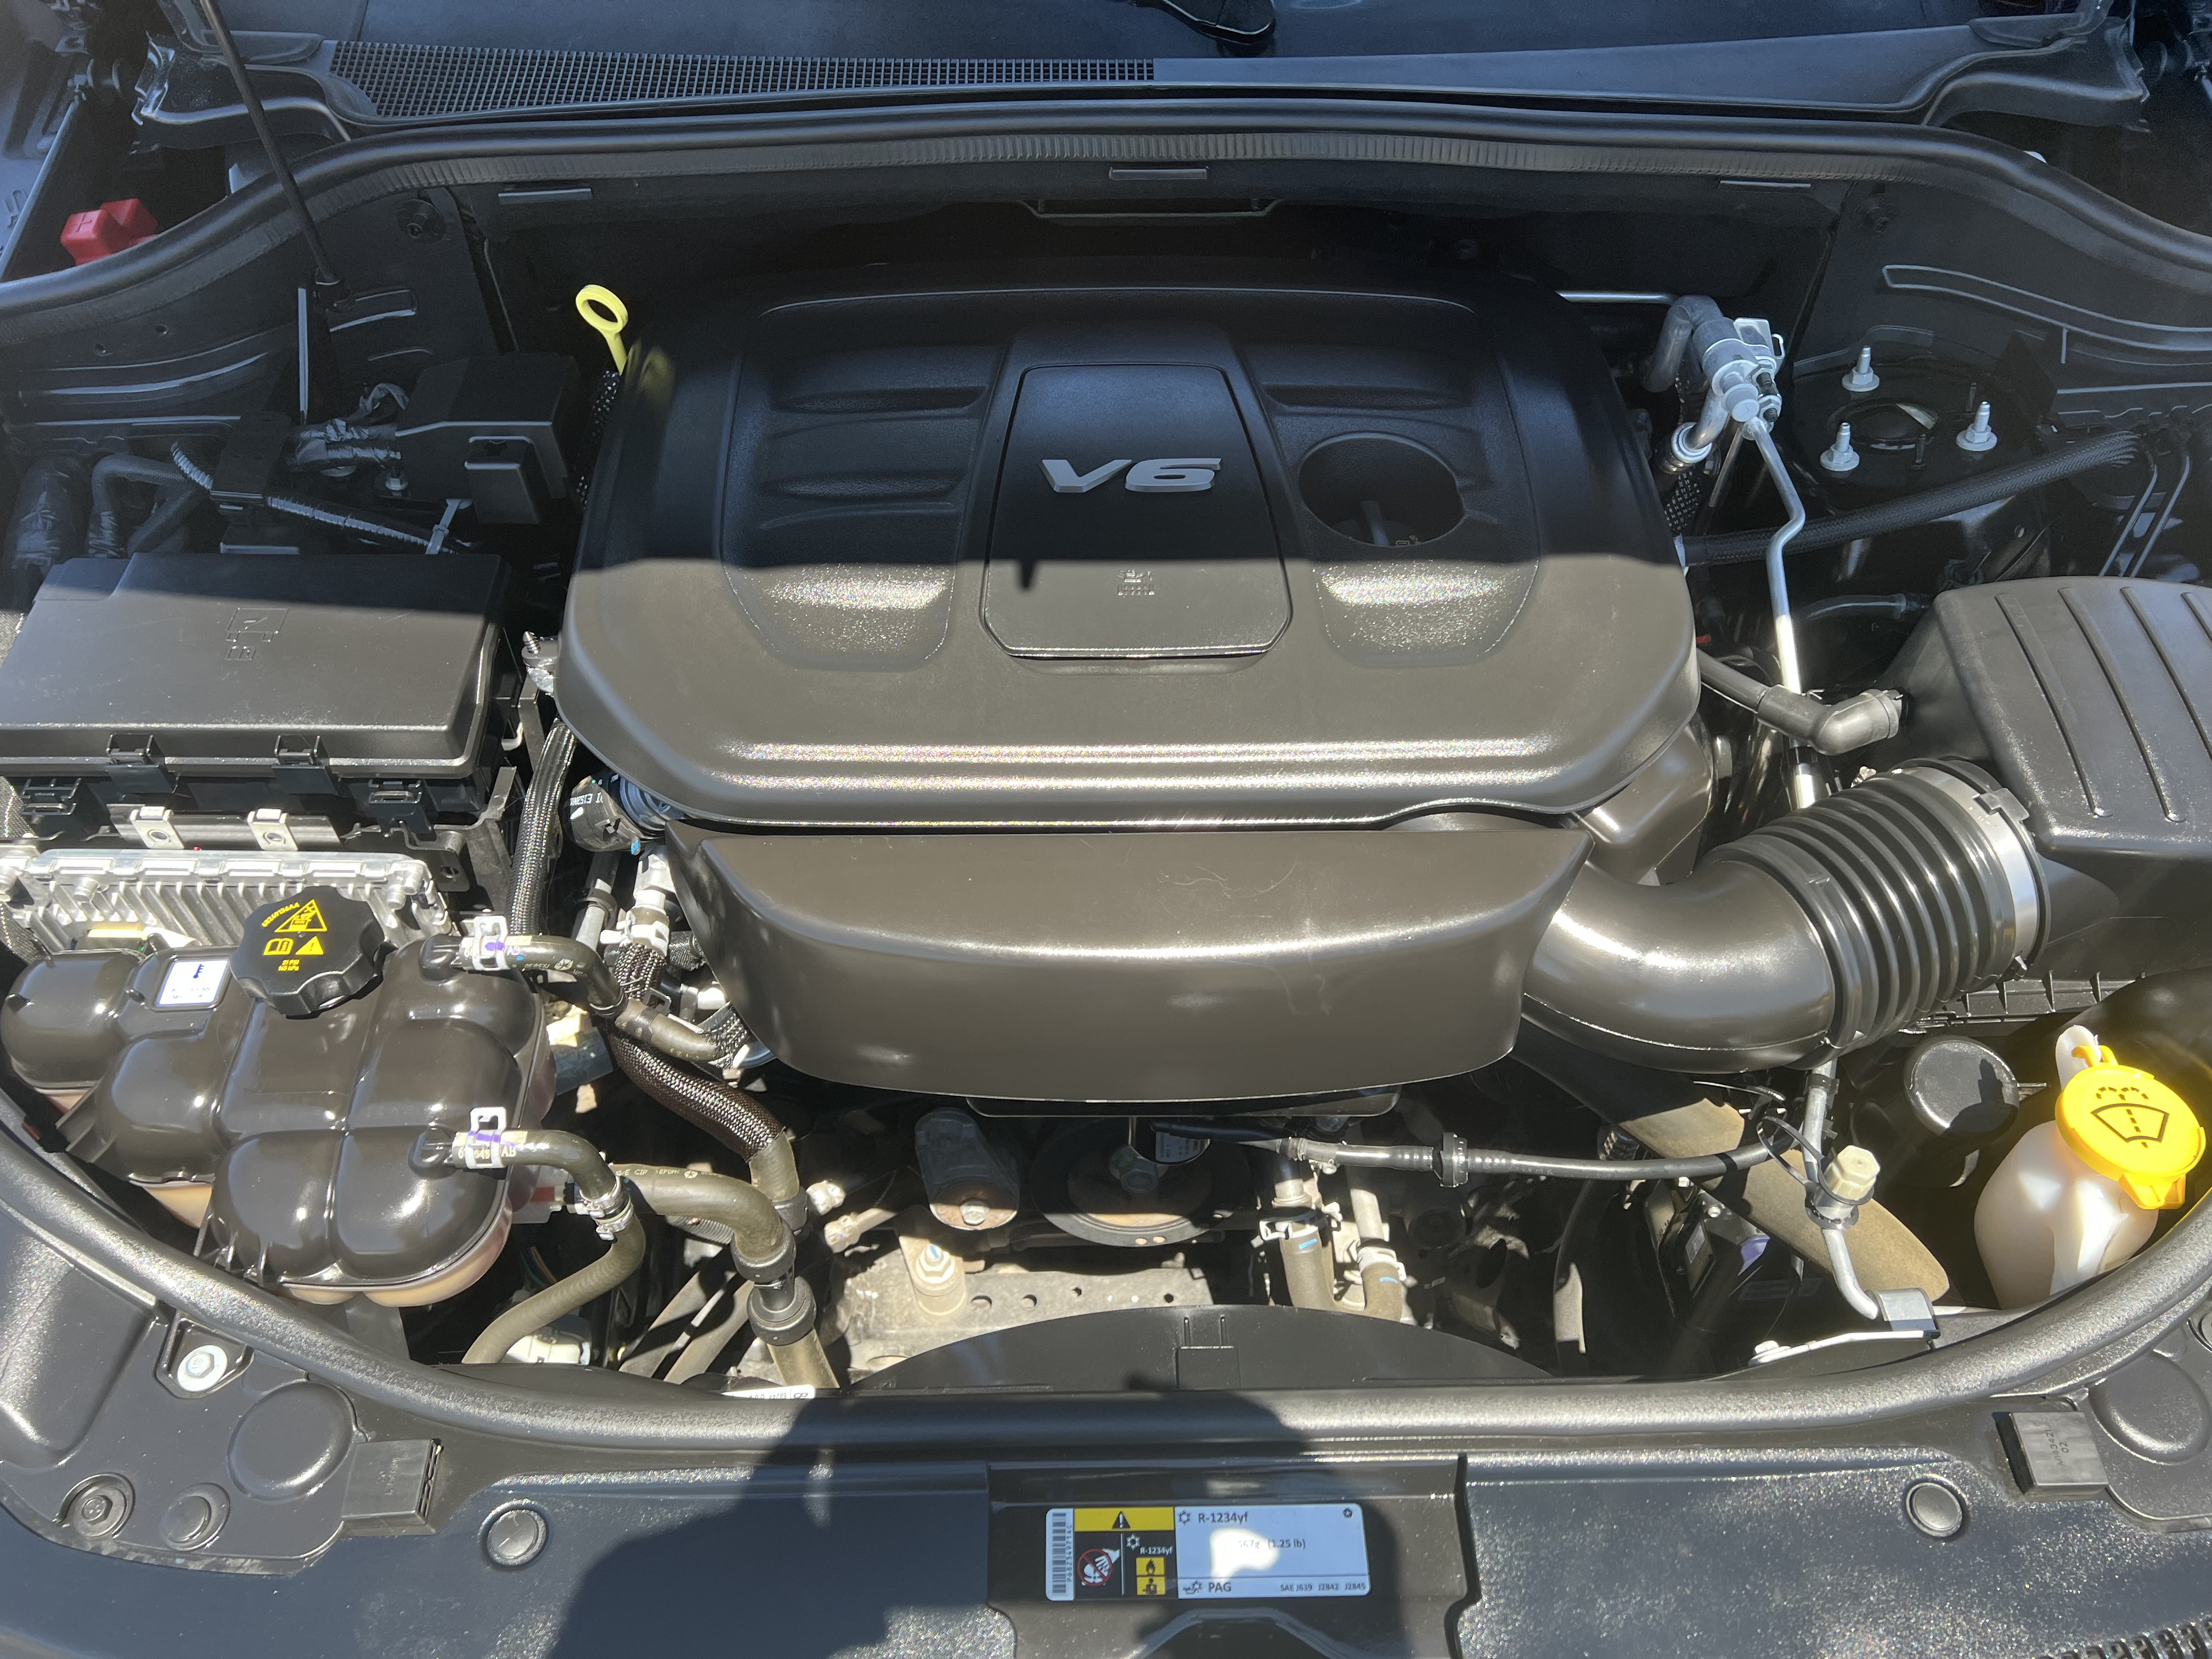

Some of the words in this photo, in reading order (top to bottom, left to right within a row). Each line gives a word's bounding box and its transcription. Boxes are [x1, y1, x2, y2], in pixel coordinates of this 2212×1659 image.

[1039, 458, 1222, 493] V6
[1198, 1511, 1248, 1525] R-1234yf
[1293, 1538, 1306, 1550] lb)
[1140, 1545, 1173, 1556] R-1234yf
[1208, 1581, 1232, 1593] PAG
[1280, 1583, 1294, 1592] SAE
[1296, 1583, 1313, 1592] J639
